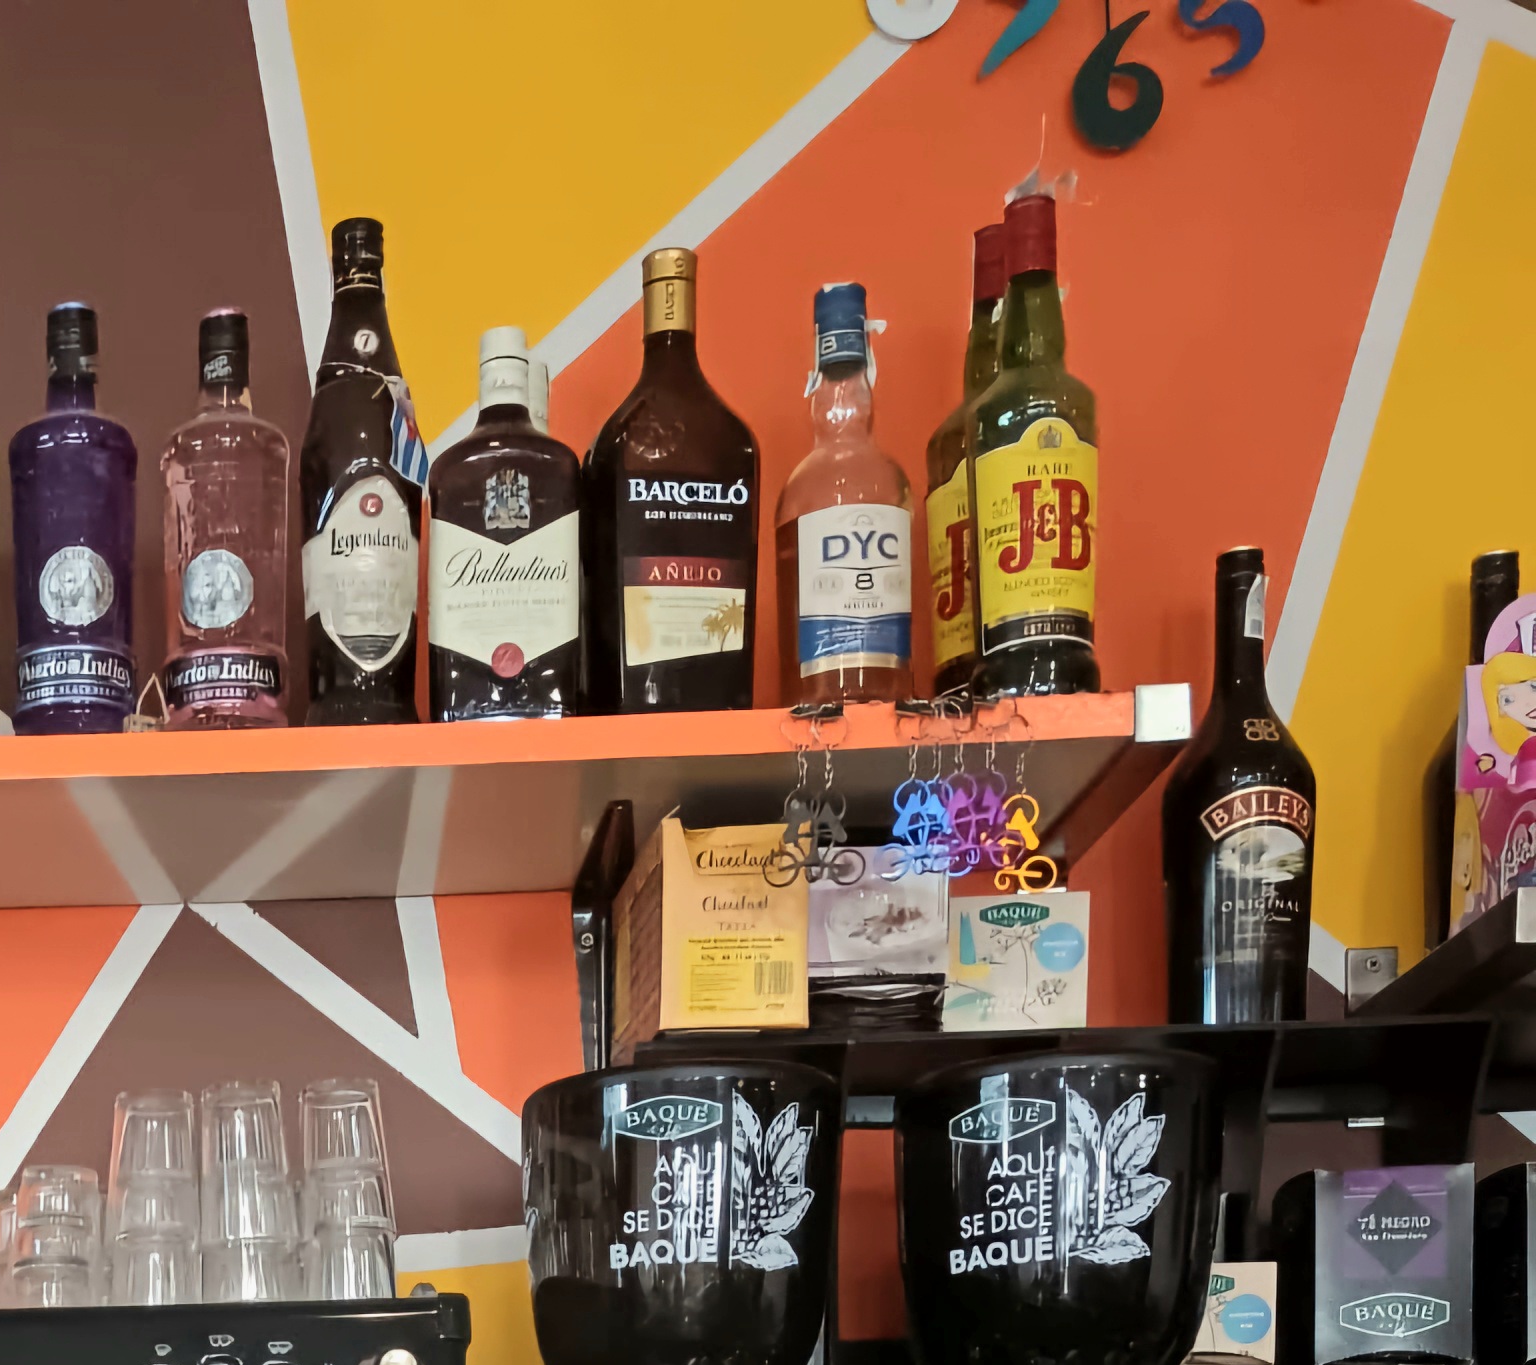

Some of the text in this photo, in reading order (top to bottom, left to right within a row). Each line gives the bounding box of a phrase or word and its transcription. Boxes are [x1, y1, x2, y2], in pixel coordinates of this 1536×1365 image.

[1072, 10, 1164, 150] 6
[628, 478, 749, 505] BARCELÓ
[998, 478, 1091, 574] J&B
[822, 530, 899, 563] DYC
[1212, 793, 1310, 828] BAILEYS
[623, 1210, 650, 1235] SE
[959, 1203, 1053, 1240] SE DICE
